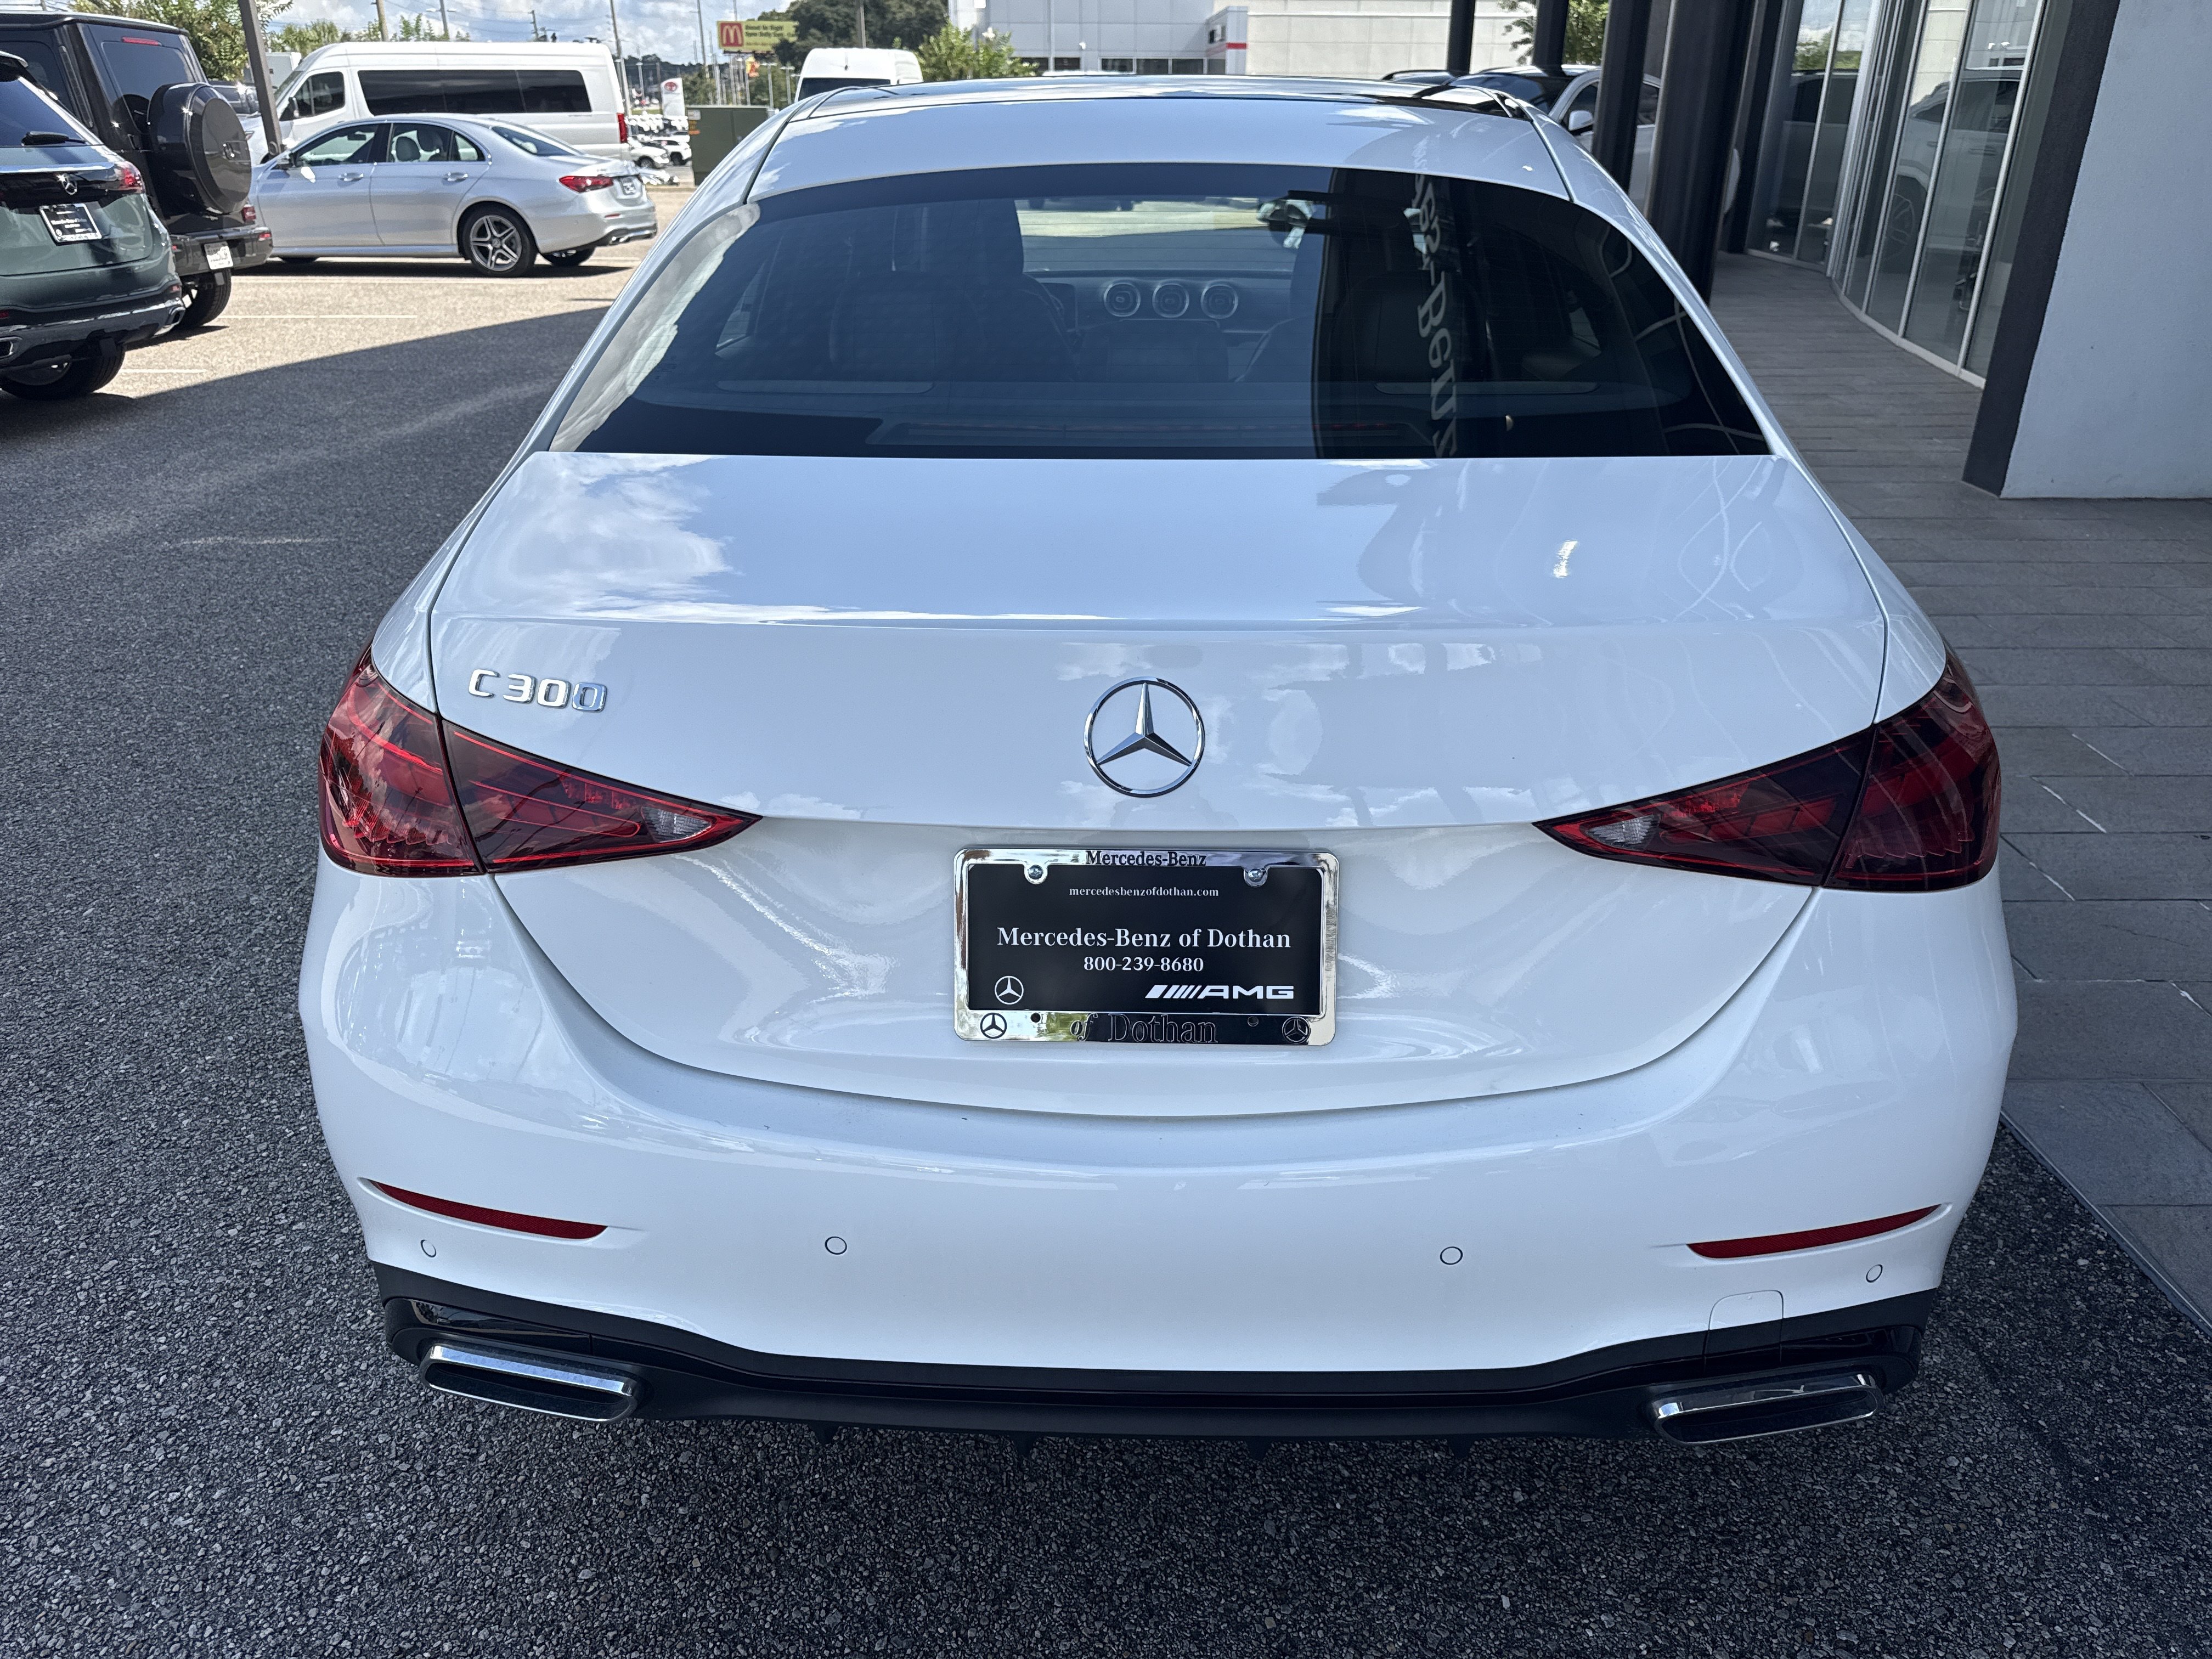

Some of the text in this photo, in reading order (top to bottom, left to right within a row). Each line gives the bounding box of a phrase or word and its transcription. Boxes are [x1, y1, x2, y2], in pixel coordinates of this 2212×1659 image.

[469, 669, 607, 713] C 300
[1085, 850, 1207, 867] Mercedes-Benz
[1069, 887, 1219, 897] mercedesbenzofdothan.com
[997, 927, 1291, 948] Mercedes-Benz of Dothan
[1084, 956, 1204, 972] 800-239-8680
[1197, 985, 1294, 999] AMG
[1070, 1012, 1218, 1043] of Dothan
